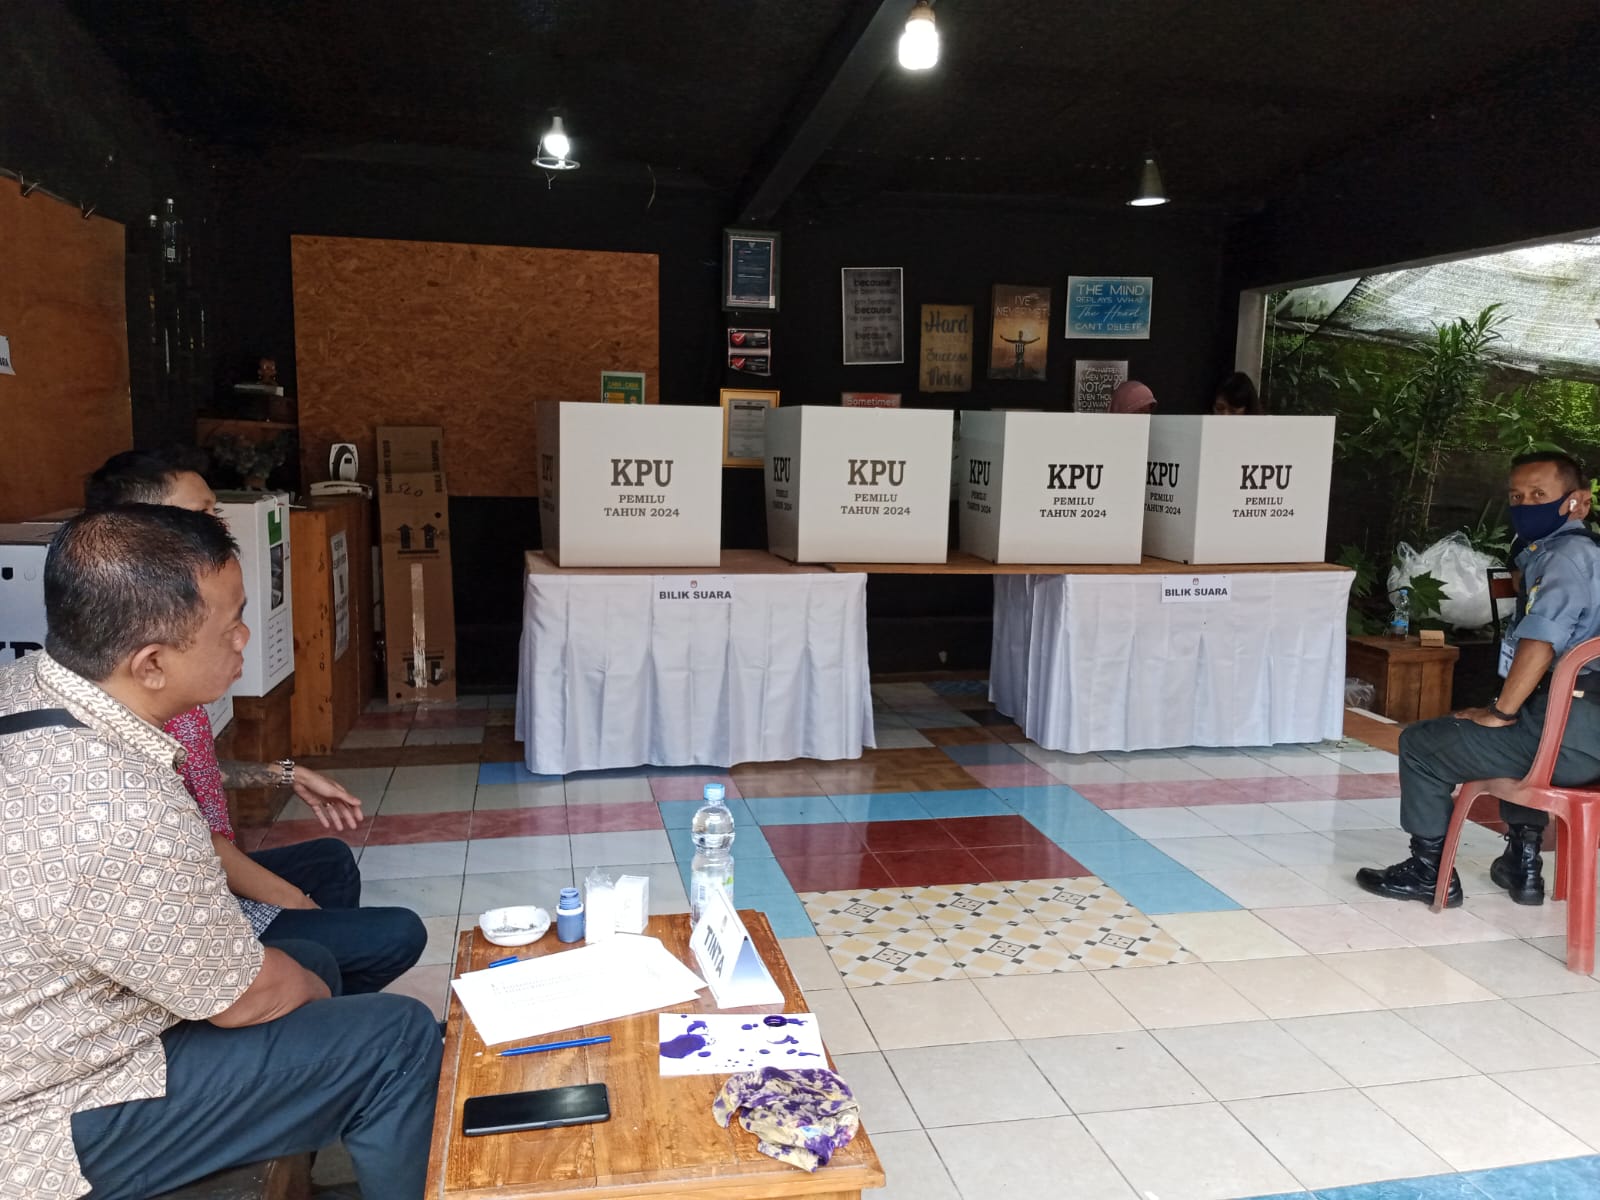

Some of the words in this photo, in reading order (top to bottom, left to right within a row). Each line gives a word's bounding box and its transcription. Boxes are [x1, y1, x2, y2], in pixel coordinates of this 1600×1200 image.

[1077, 284, 1104, 296] THE
[1110, 284, 1145, 296] MIND
[1076, 296, 1113, 304] REPLAYS
[925, 310, 968, 334] Hard
[1107, 322, 1142, 331] DELETE
[926, 348, 968, 361] Success
[1078, 382, 1099, 393] NOT
[847, 396, 897, 406] Sometimes
[1078, 393, 1096, 401] EVEN
[610, 458, 674, 487] KPU
[773, 456, 791, 483] KPU
[847, 459, 906, 487] KPU
[969, 459, 991, 486] KPU
[1146, 461, 1180, 488] KPU
[1046, 464, 1104, 490] KPU
[1240, 464, 1293, 490] KPU
[618, 494, 665, 504] PEMILU
[854, 493, 898, 503] PEMILU
[1053, 497, 1094, 506] PEMILU
[1150, 492, 1174, 503] PEMILU
[1245, 497, 1284, 506] PEMILU
[604, 507, 646, 517] TAHUN
[650, 508, 680, 517] 2024
[841, 505, 879, 515] TAHUN
[883, 506, 911, 516] 2024
[1040, 509, 1077, 518] TAHUN
[1080, 509, 1107, 518] 2024
[1164, 505, 1181, 515] 2024
[1232, 509, 1267, 518] TAHUN
[1270, 509, 1295, 517] 2024
[659, 591, 690, 600] BILIK
[692, 591, 732, 600] SUARA
[1164, 588, 1191, 597] BILIK
[1194, 587, 1228, 597] SUARA
[704, 924, 725, 979] TINTA
